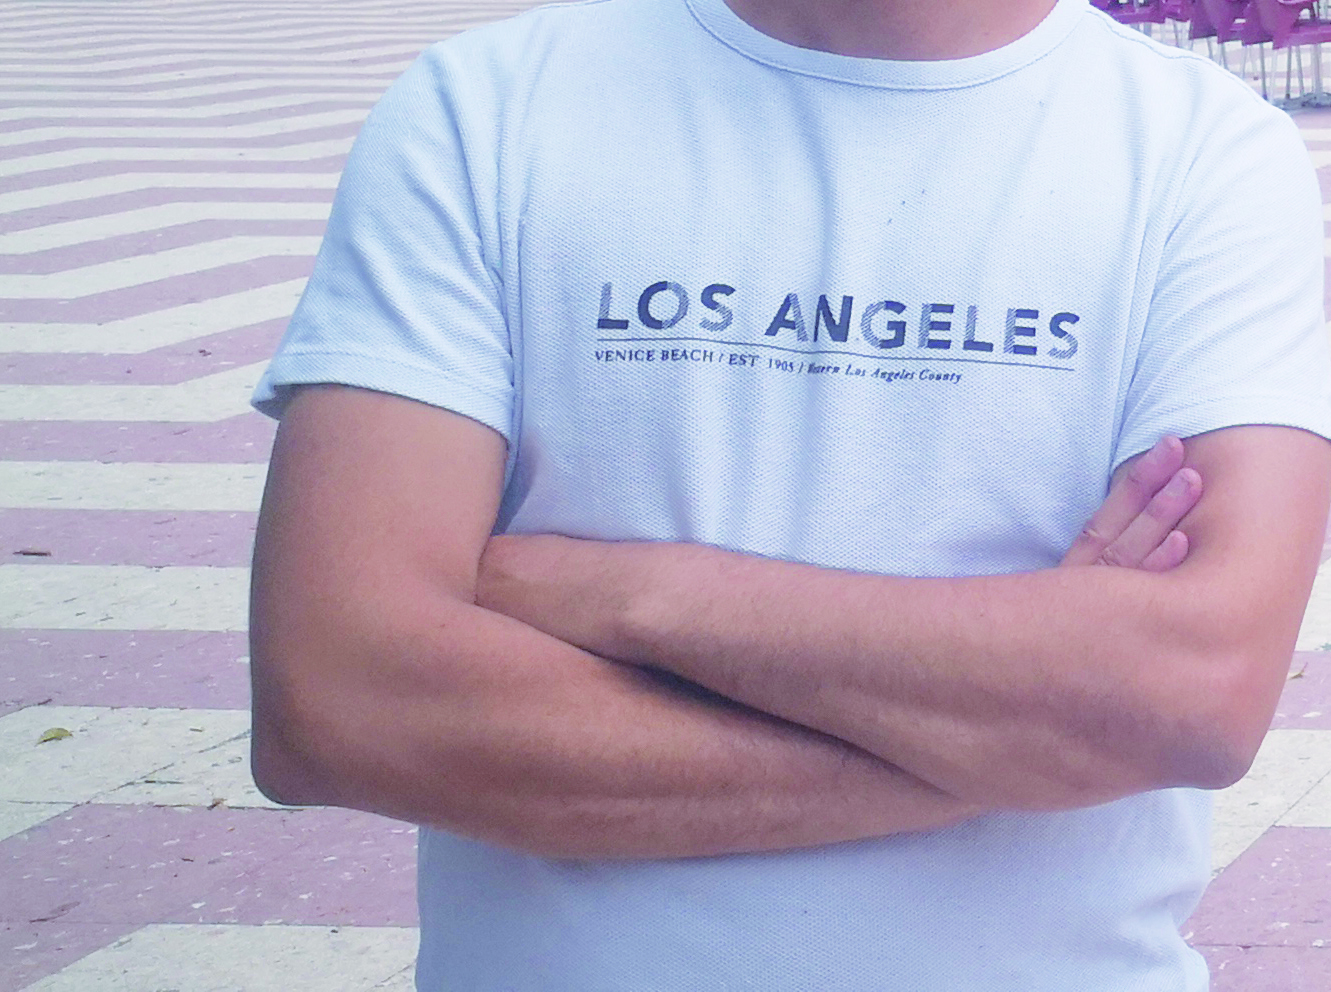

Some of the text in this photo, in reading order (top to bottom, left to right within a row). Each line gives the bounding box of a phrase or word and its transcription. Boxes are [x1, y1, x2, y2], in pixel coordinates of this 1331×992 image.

[596, 280, 1080, 360] LOS ANGELES
[595, 349, 656, 363] VENICE
[660, 349, 714, 363] BEACH
[728, 353, 760, 367] EST
